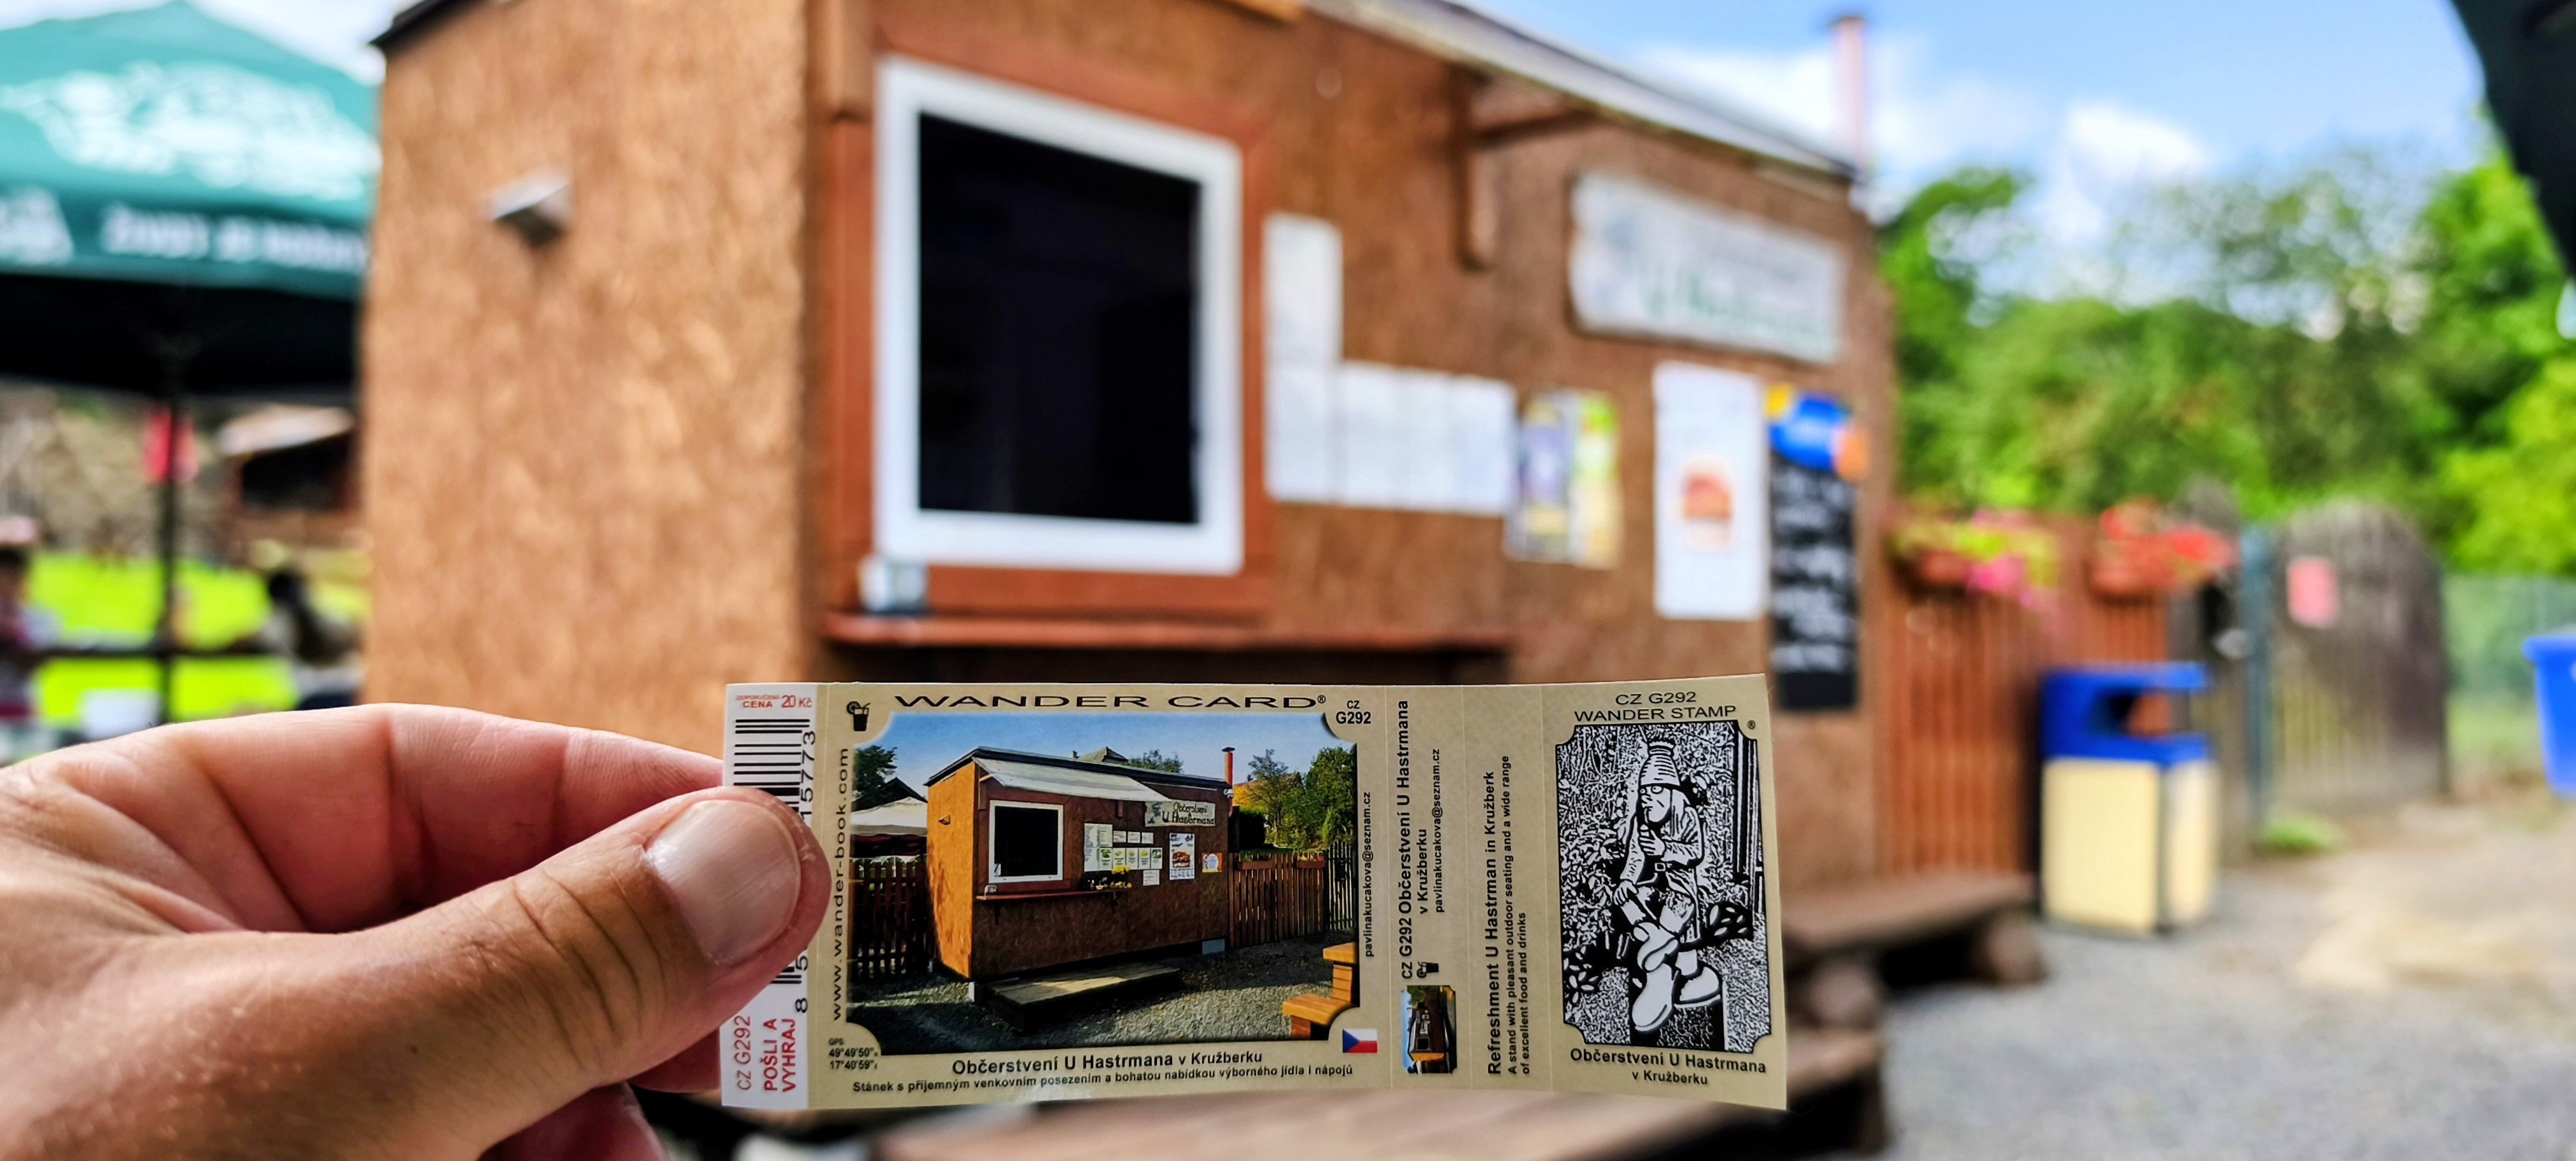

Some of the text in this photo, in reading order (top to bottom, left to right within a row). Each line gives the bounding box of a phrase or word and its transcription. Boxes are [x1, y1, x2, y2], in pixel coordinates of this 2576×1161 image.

[781, 695, 796, 708] 20
[799, 697, 813, 708] Kč
[895, 695, 1151, 707] WANDER
[1347, 700, 1360, 709] CZ
[1616, 692, 1697, 705] CZ G292
[1336, 711, 1372, 725] G292
[1575, 708, 1664, 722] WANDER
[1670, 706, 1736, 719] STAMP
[800, 731, 816, 821] 15773
[1501, 756, 1512, 787] range
[1162, 811, 1169, 823] U
[1501, 792, 1511, 817] wide
[1396, 700, 1413, 979] CZ G292 Občerstvení U Hastrmana
[1431, 749, 1445, 913] pavlinakucakova@seznam.cz
[1501, 831, 1511, 852] and
[834, 748, 849, 1021] www.wander-book.com
[1362, 792, 1375, 957] pavlinakucakova@seznam.cz
[1415, 829, 1429, 914] v Kružberku
[1502, 856, 1514, 896] seating
[1483, 772, 1501, 1074] Refreshment U Hastrman in Kružberk
[1504, 900, 1514, 945] outdoor
[1505, 950, 1517, 998] pleasant
[795, 998, 808, 1013] 8
[1516, 913, 1530, 1074] of excellent food and drinks
[1506, 1001, 1516, 1025] with
[734, 1015, 752, 1090] CZ G292
[760, 1018, 778, 1091] POŠLI A
[781, 1019, 795, 1092] VYHRAJ
[1506, 1029, 1517, 1062] stand
[1570, 1048, 1766, 1073] Občerstvení U Hastrmana
[853, 1081, 893, 1092] Stánek
[908, 1080, 970, 1093] příjemným
[974, 1075, 1036, 1088] venkovním
[1040, 1073, 1102, 1088] posezením
[1115, 1071, 1161, 1082] bohatou
[1165, 1069, 1215, 1080] nabídkou
[1219, 1066, 1278, 1080] výborného
[1281, 1064, 1305, 1078] jídla
[1315, 1063, 1353, 1077] nápojů
[952, 1052, 1263, 1075] Občerstvení U Hastrmana v Kružberku
[1508, 1066, 1517, 1074] A
[1632, 1069, 1707, 1085] v Kružberku
